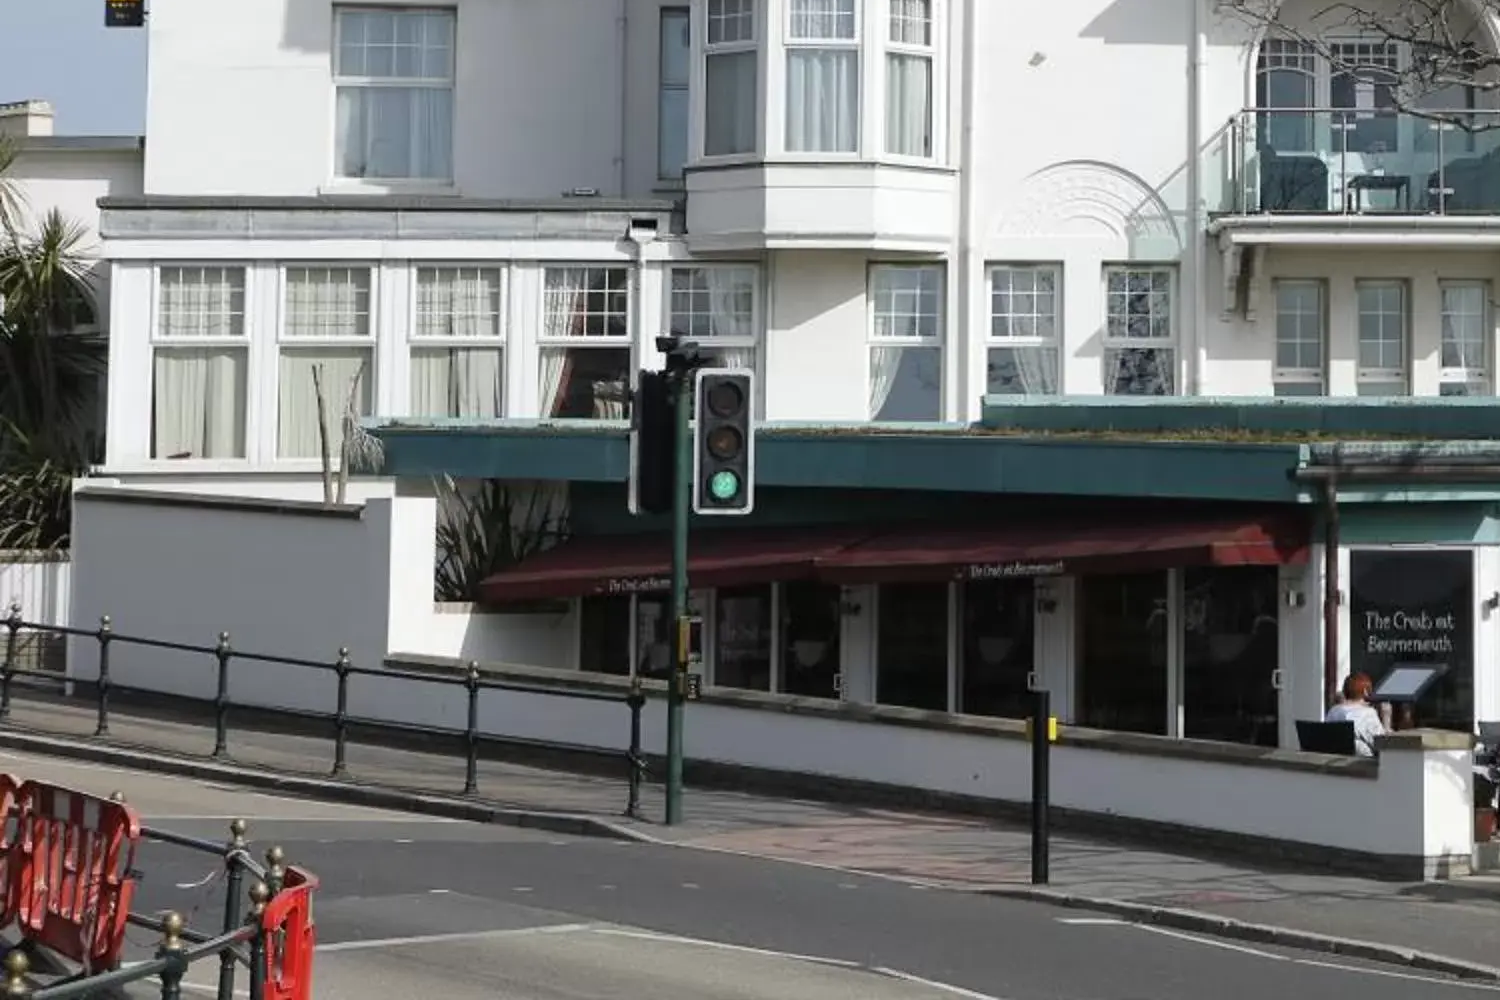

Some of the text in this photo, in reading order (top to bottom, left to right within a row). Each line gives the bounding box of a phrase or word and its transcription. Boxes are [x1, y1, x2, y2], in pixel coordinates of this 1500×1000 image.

[1365, 609, 1455, 631] The Crab at
[1367, 634, 1454, 653] Bournemouth
